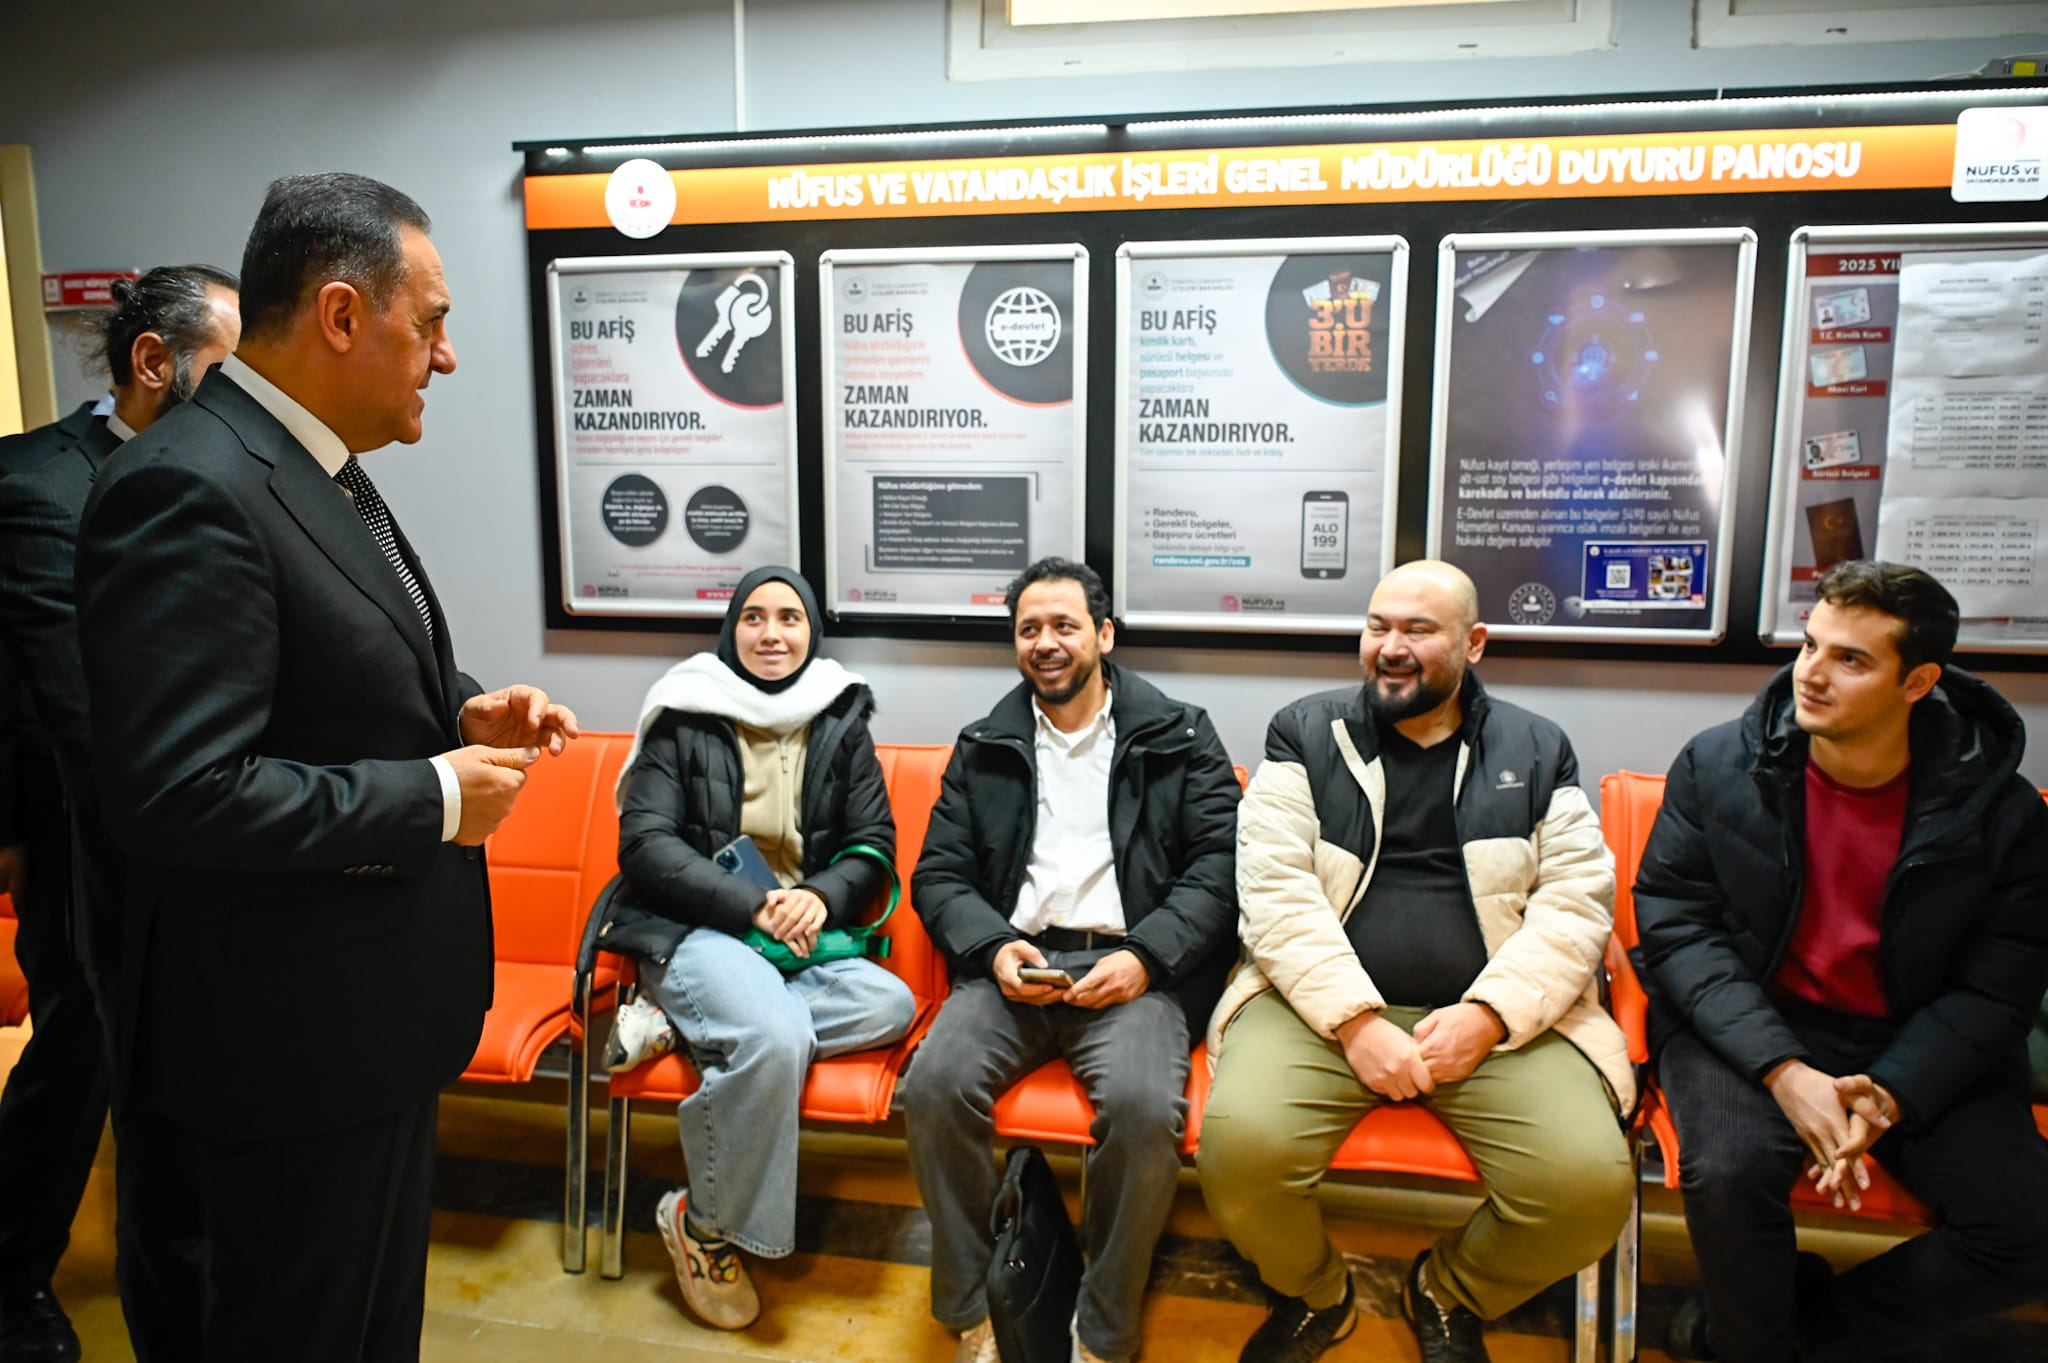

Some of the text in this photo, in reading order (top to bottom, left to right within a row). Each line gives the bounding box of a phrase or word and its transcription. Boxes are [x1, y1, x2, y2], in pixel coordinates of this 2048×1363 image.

[768, 142, 1862, 208] NÜFUS VE VATANDAŞLIK İŞLERİ GENEL MÜDÜRLÜĞÜ DUYURU PANOSU
[1839, 259, 1877, 273] 2025
[844, 308, 914, 338] BU AFİŞ
[1000, 322, 1045, 331] e-devlet
[1141, 305, 1217, 335] BU AFİŞ
[571, 315, 635, 343] BU AFİŞ
[1140, 335, 1169, 347] kimlik
[1308, 323, 1372, 356] BİR
[1140, 351, 1174, 364] sürücü
[1175, 351, 1212, 364] belgesi
[1140, 367, 1184, 380] pasaport
[573, 389, 633, 408] ZAMAN
[844, 385, 909, 405] ZAMAN
[1139, 398, 1210, 419] ZAMAN
[574, 411, 706, 431] KAZANDIRIYOR.
[844, 409, 989, 429] KAZANDIRIYOR.
[1139, 422, 1295, 443] KAZANDIRIYOR.
[1602, 473, 1648, 486] e-devlet
[1458, 487, 1509, 499] karekodlu
[1510, 487, 1524, 499] ve
[1525, 487, 1571, 499] barkodlu
[1573, 487, 1606, 499] olarak
[1152, 508, 1199, 518] Randevu,
[1152, 519, 1233, 531] Gerekli belgeler,
[1312, 523, 1339, 534] ALO
[1152, 530, 1237, 541] Başvuru ücretleri
[1312, 535, 1338, 547] 199
